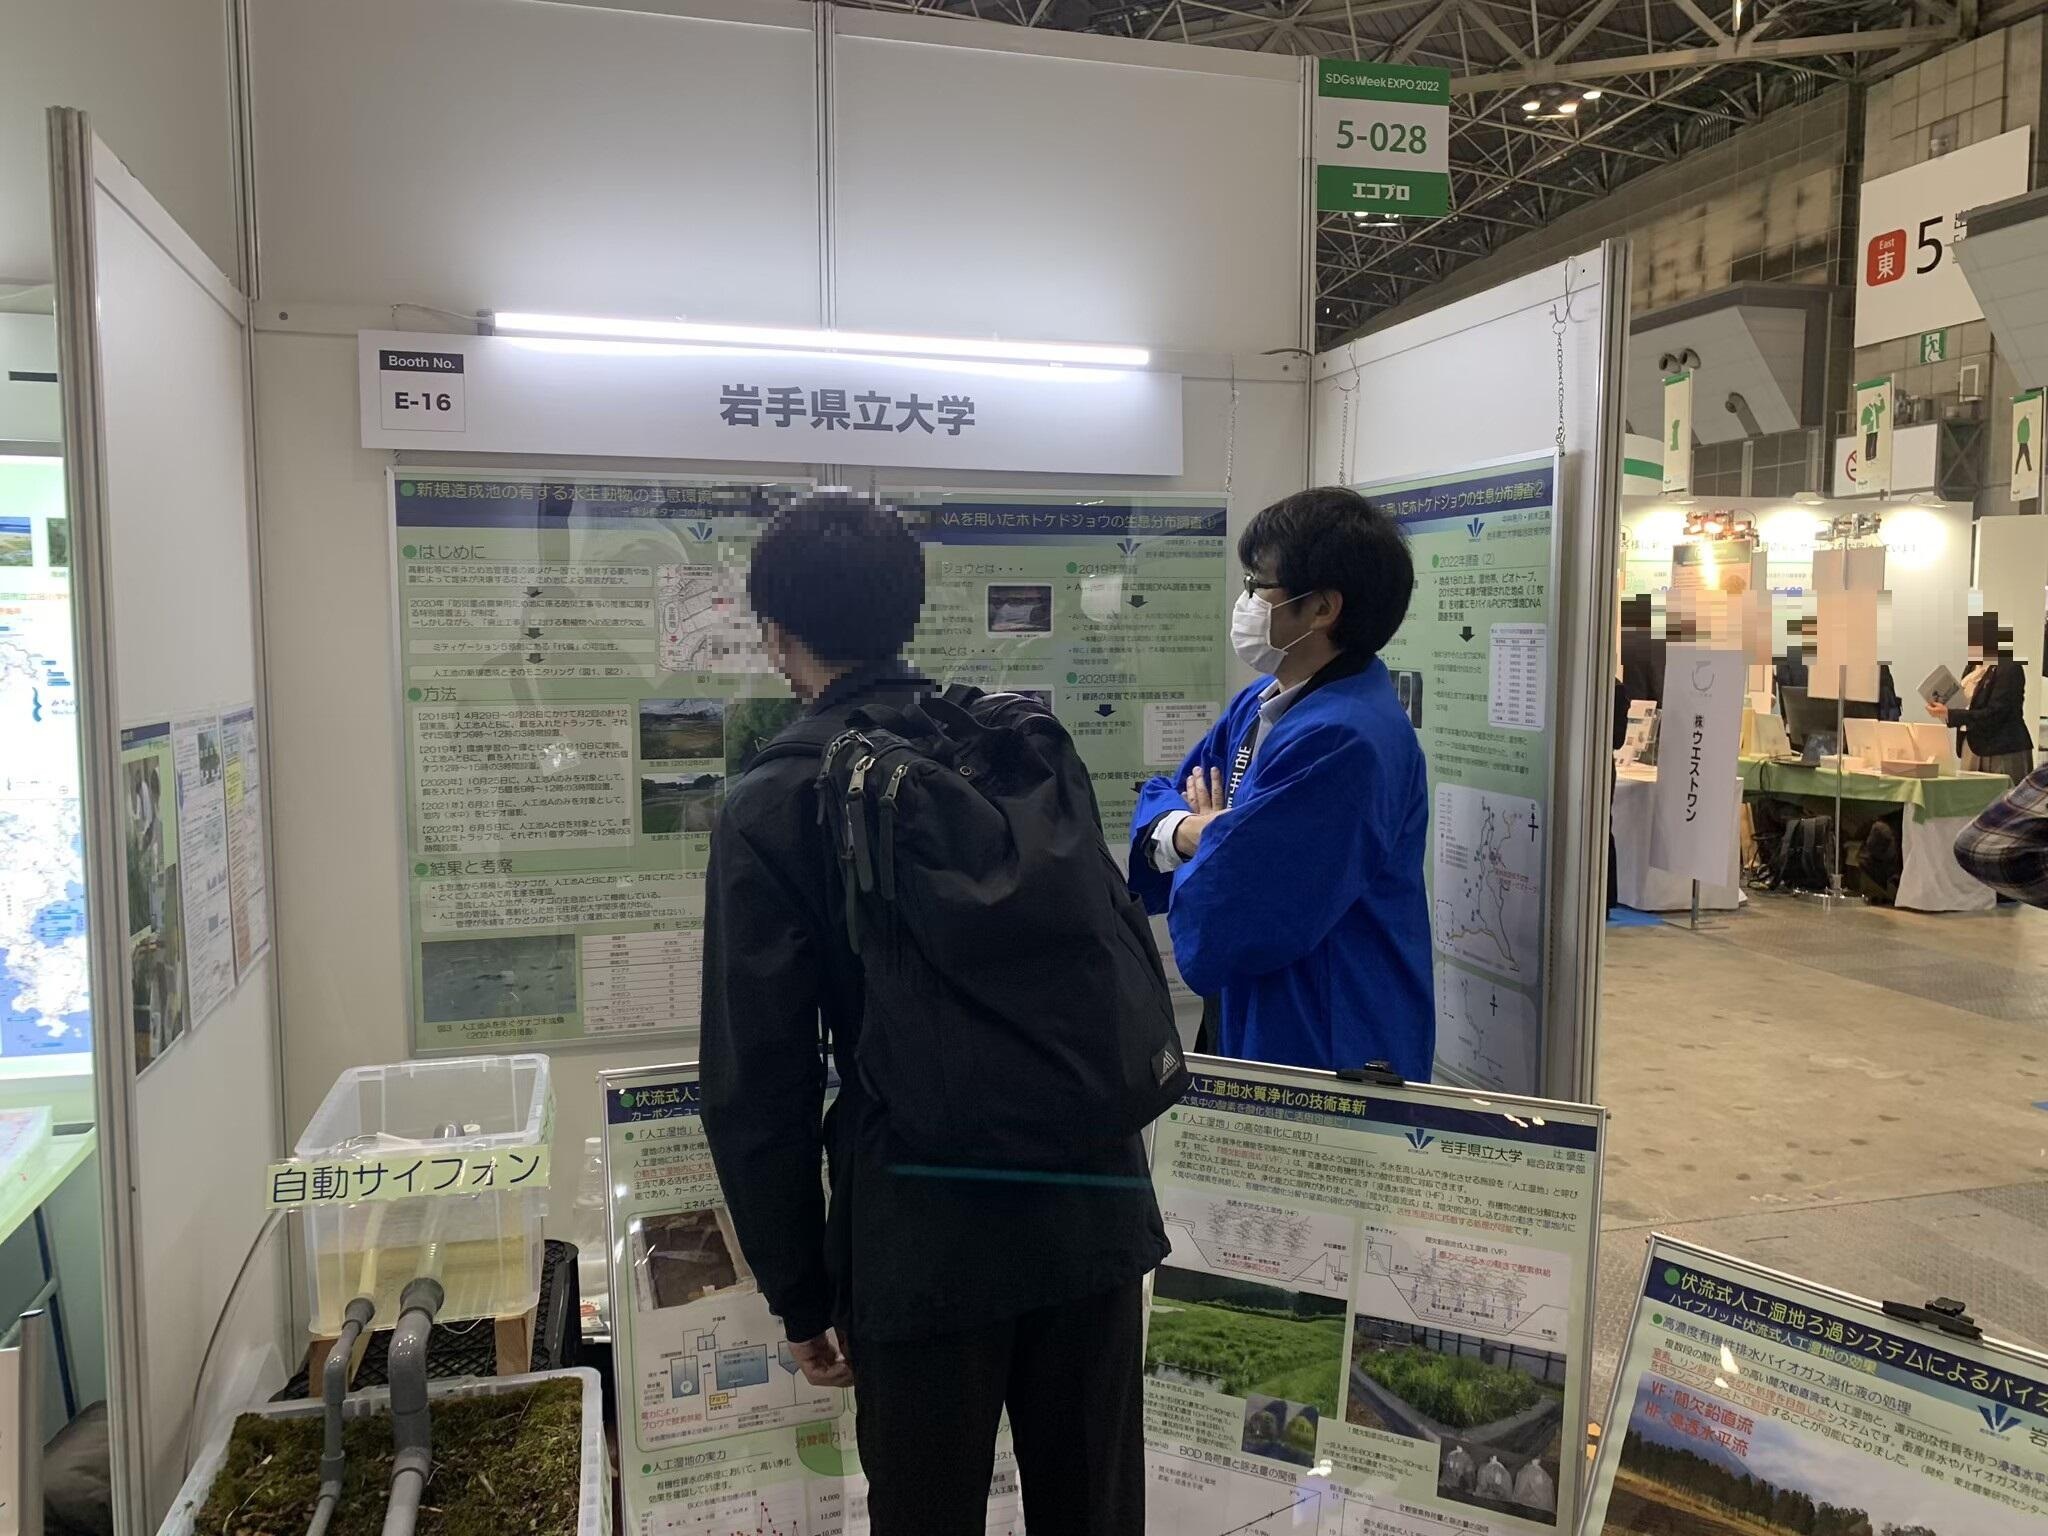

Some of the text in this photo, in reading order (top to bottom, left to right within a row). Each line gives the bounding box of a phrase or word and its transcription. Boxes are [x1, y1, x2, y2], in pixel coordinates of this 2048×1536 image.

[1416, 82, 1440, 92] 2022
[1336, 120, 1427, 154] 5-028
[1352, 182, 1410, 201] エコプロ
[1877, 252, 1895, 279] 東
[1917, 216, 1943, 274] 5
[1880, 238, 1895, 250] East
[388, 355, 455, 369] Booth No.
[395, 392, 451, 411] E-16
[720, 384, 975, 436] 岩手県立大学
[418, 544, 486, 560] はじめに
[423, 687, 457, 701] 方法
[430, 858, 513, 874] 結果と考察
[1187, 1077, 1367, 1116] 人工湿地水質浄化の技術革新
[1441, 1139, 1523, 1163] 岩手県立大学
[1527, 1158, 1586, 1175] 総合政策学部
[273, 1155, 540, 1203] 自動サイフォン
[1669, 1294, 1879, 1375] ハイブリッド伏流式人工湿地の効果
[1662, 1316, 1912, 1417] 高濃度有機性排水バイオガス消化液の処理
[653, 1450, 727, 1472] 人工湿地の実力
[1179, 1445, 1202, 1460] BOD
